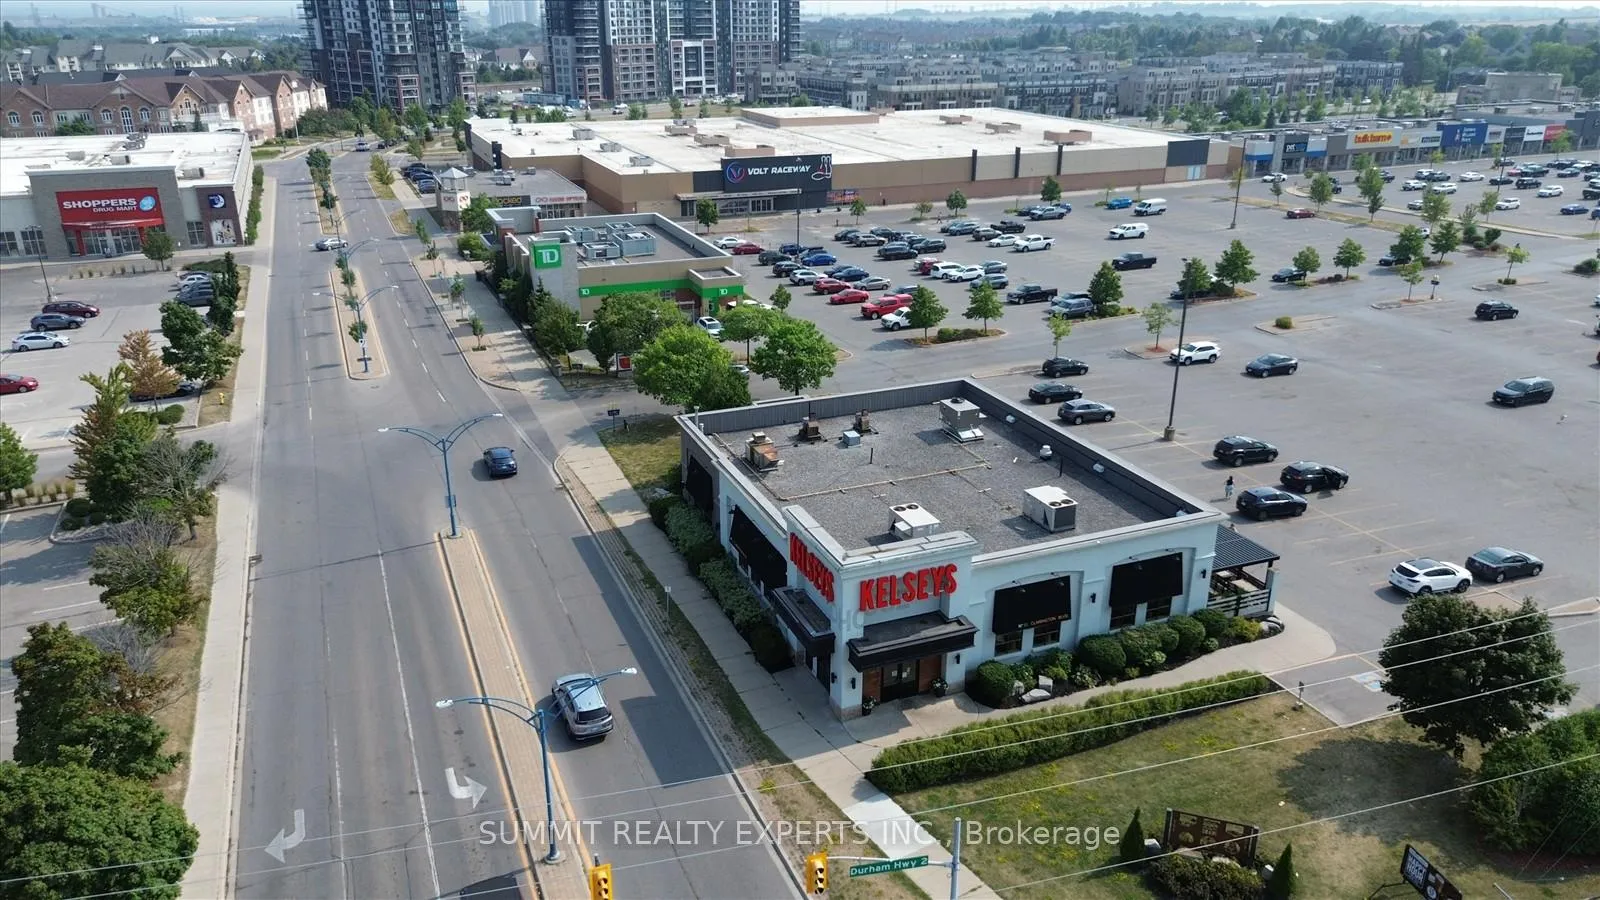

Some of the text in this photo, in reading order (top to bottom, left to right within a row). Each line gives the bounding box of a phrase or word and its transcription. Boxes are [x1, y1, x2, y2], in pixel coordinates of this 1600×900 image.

[747, 165, 811, 176] VOLT RACEWAY
[63, 198, 137, 209] SHOPPERS
[537, 249, 559, 264] TD
[859, 563, 958, 612] KELSEYS
[850, 857, 928, 875] Durham Hwy 2
